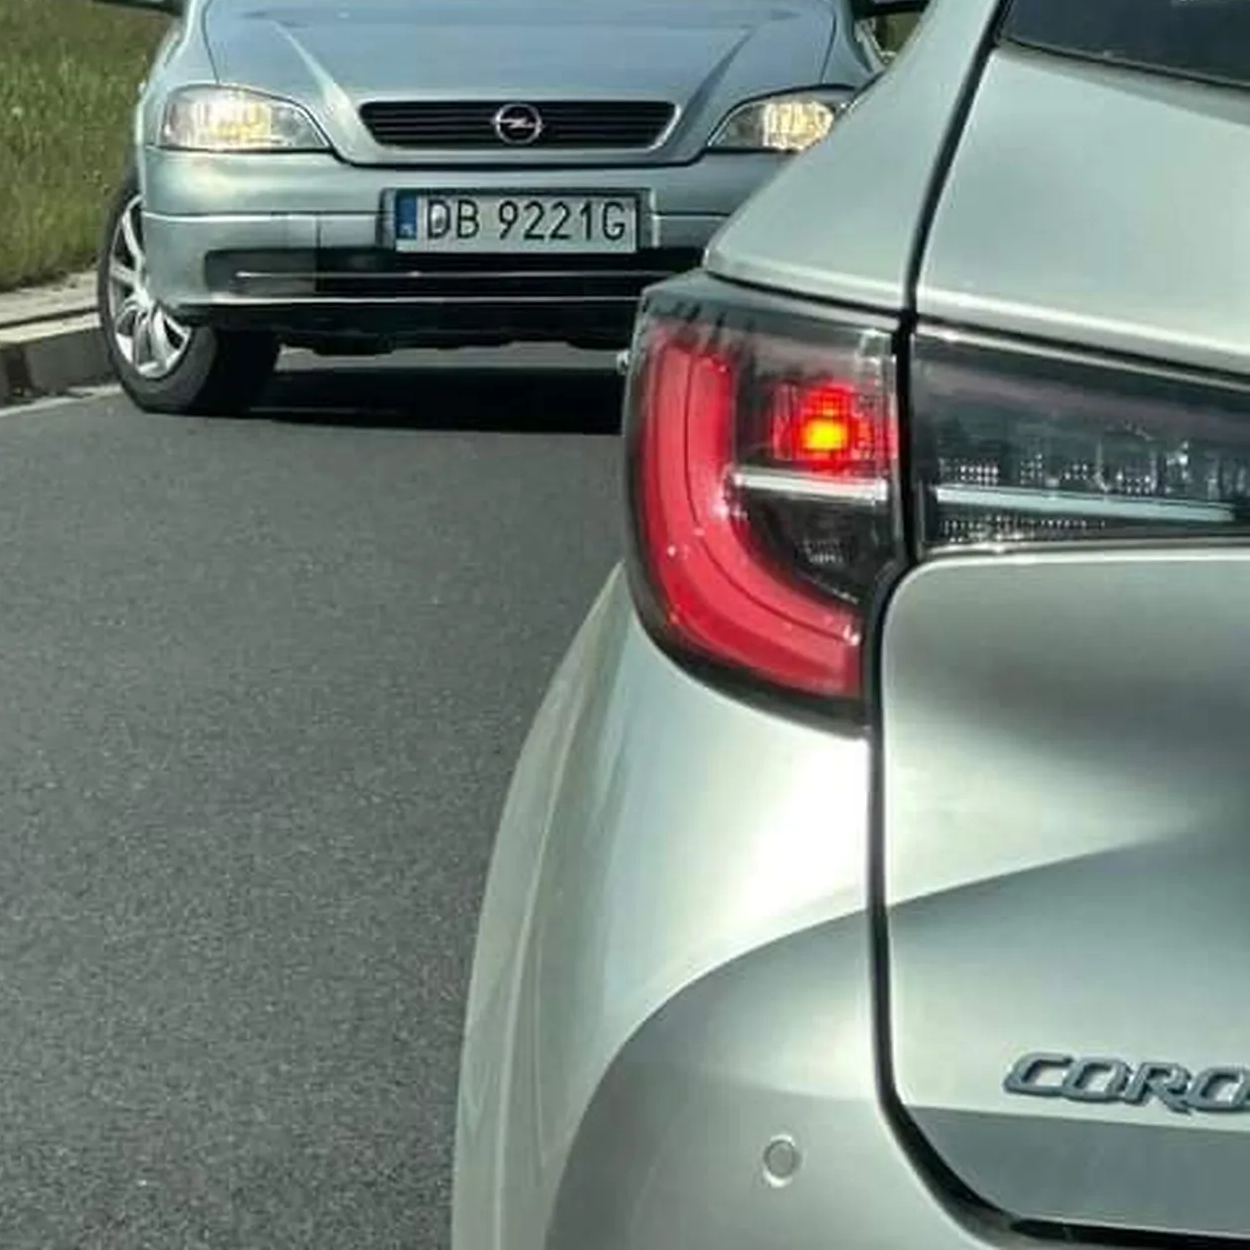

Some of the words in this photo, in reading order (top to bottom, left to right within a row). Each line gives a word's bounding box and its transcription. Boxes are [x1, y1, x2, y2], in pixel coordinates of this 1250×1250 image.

[427, 199, 480, 240] DB
[498, 199, 626, 241] 9221G
[1002, 1051, 1250, 1116] CORO
